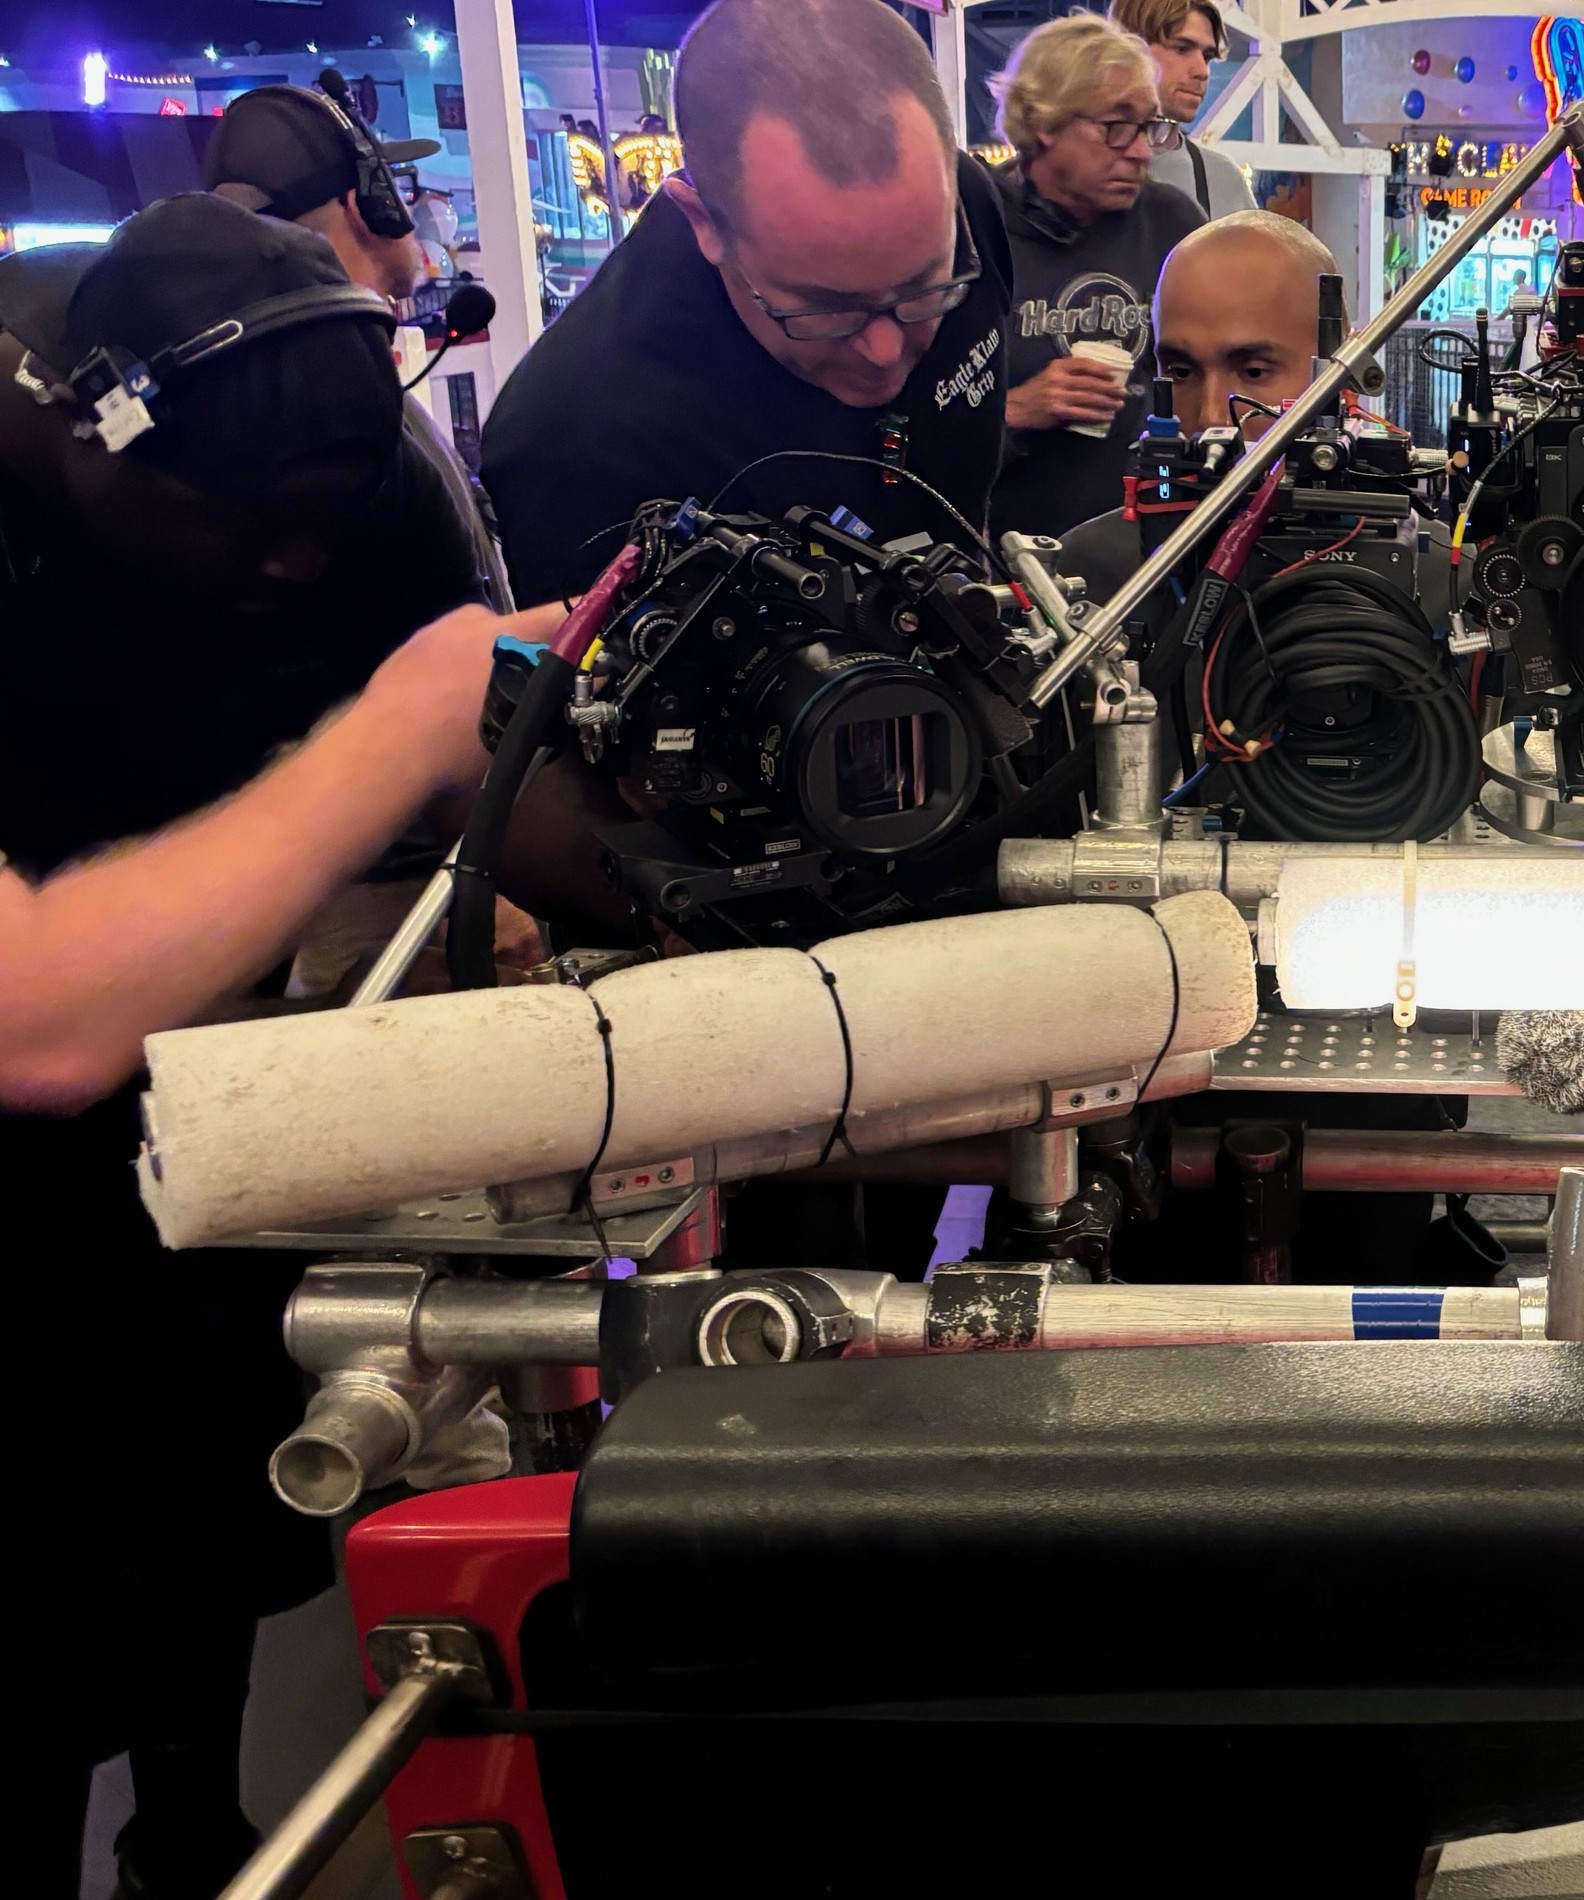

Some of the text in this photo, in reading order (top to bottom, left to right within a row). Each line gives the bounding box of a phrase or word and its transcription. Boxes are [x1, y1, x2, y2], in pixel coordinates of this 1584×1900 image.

[1019, 294, 1150, 338] Hard Roc
[934, 362, 976, 411] Eagle
[966, 369, 996, 408] Grip
[760, 752, 775, 777] 60
